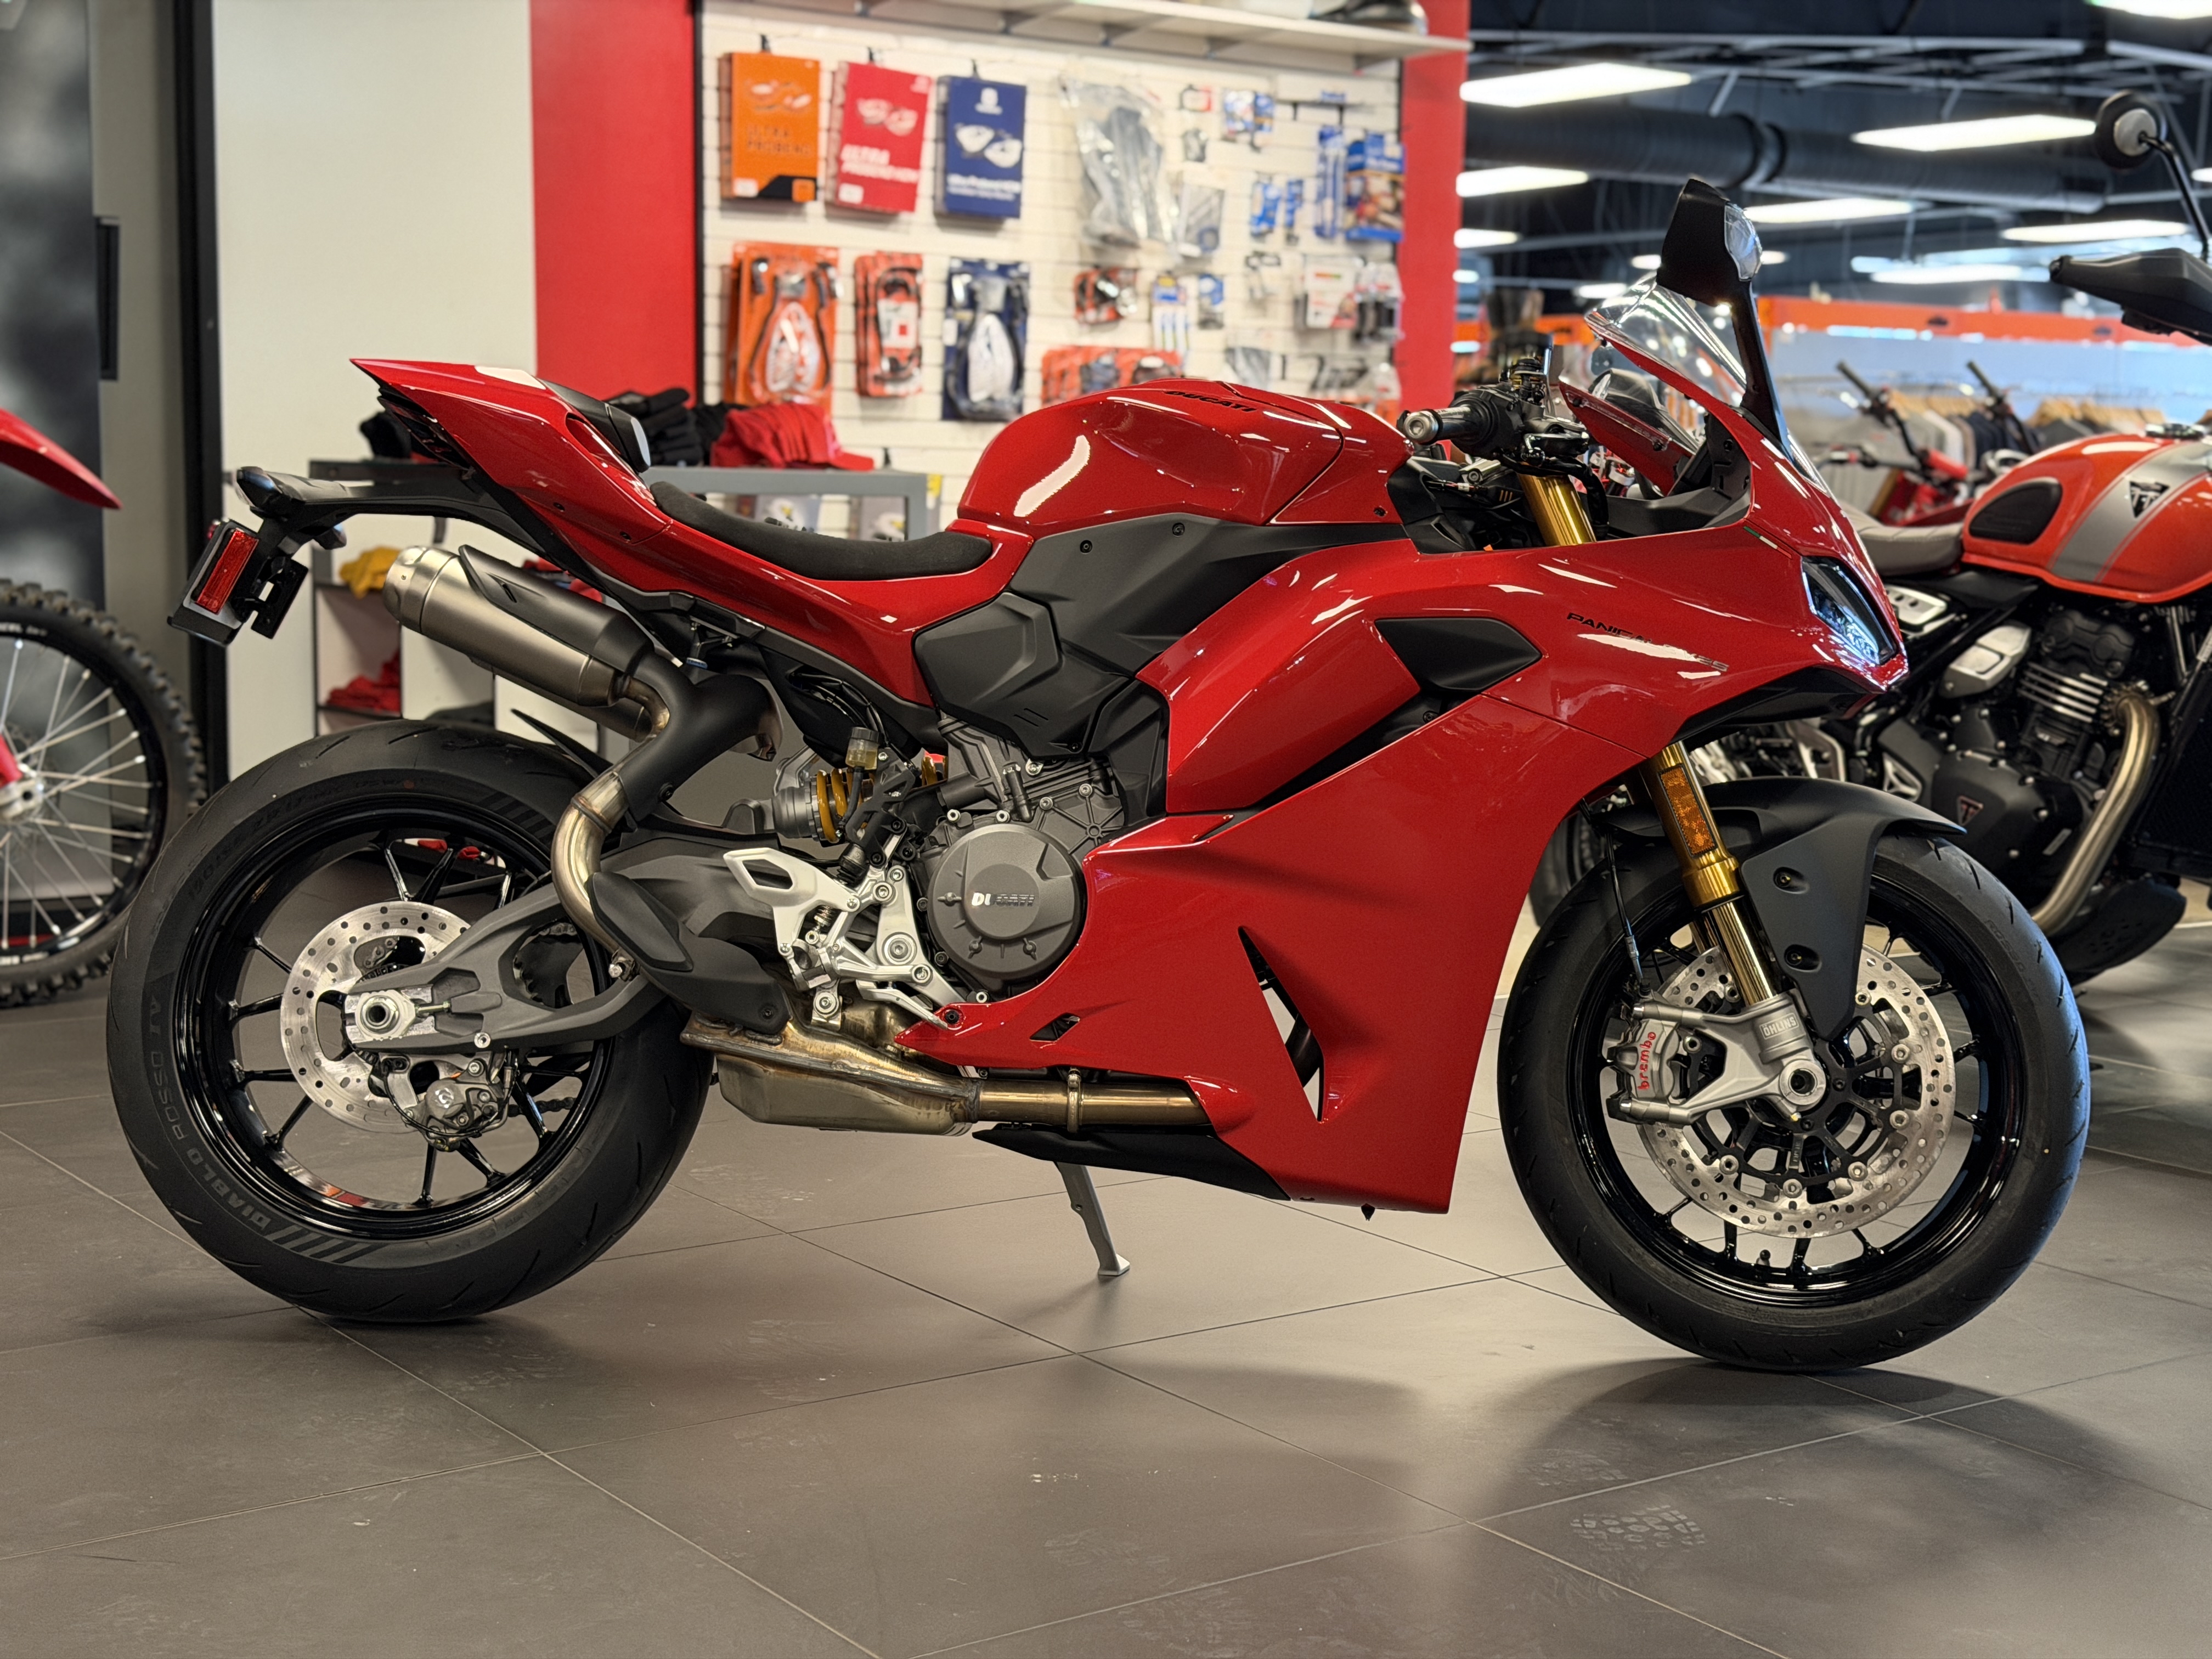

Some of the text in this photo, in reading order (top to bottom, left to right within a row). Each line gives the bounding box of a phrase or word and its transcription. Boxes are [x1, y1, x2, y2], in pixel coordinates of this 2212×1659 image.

[1164, 391, 1257, 412] DUCATI
[1763, 1016, 1797, 1036] ÖHLINS
[1638, 1031, 1656, 1090] brembo
[151, 1051, 188, 1140] ROSSO
[187, 1147, 272, 1231] DIABLO
